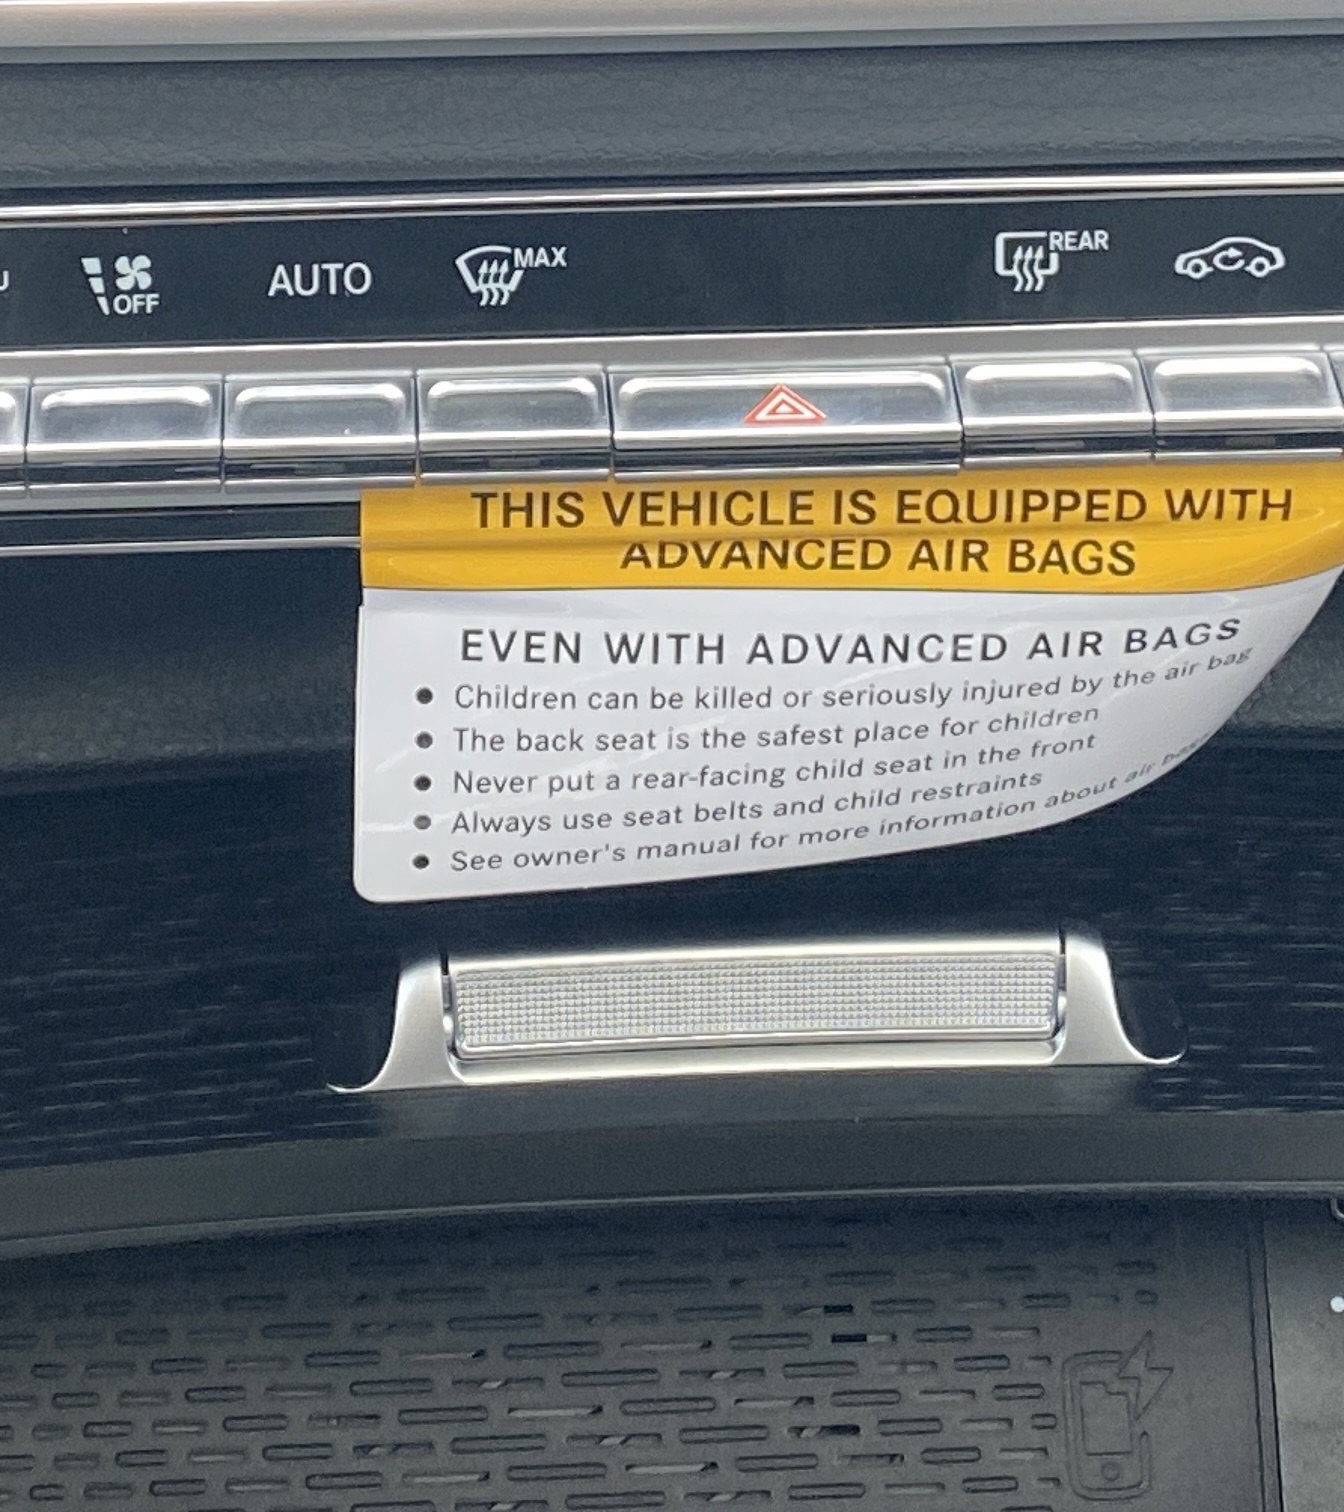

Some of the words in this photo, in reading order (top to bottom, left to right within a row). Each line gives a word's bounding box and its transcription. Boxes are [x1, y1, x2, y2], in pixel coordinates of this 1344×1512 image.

[514, 246, 567, 270] MAX
[1049, 230, 1109, 252] REAR
[268, 261, 373, 298] AUTO
[114, 293, 160, 316] OFF
[471, 491, 585, 528] THIS
[602, 490, 814, 527] VEHICLE
[834, 488, 877, 525] IS
[896, 489, 1147, 525] EQUIPPED
[1165, 488, 1293, 521] WITH
[620, 538, 892, 570] ADVANCED
[908, 539, 989, 572] AIR
[1008, 539, 1137, 577] BAGS
[461, 628, 582, 665] EVEN
[603, 632, 725, 665] WITH
[746, 633, 1007, 665] ADVANCED
[1027, 630, 1103, 660] AIR
[1123, 617, 1241, 654] BAGS
[455, 684, 577, 710] Children
[588, 690, 639, 711] can
[650, 686, 685, 710] be
[695, 684, 772, 710] killed
[783, 689, 812, 708] or
[822, 681, 952, 707] seriously
[962, 678, 1061, 705] injured
[1071, 674, 1103, 696] by
[1112, 668, 1156, 689] the
[1164, 660, 1199, 682] air
[1207, 647, 1254, 673] bag
[453, 727, 505, 753] The
[517, 727, 585, 752] back
[595, 729, 657, 752] seat
[667, 727, 690, 750] is
[700, 725, 747, 749] the
[756, 724, 844, 747] safest
[853, 721, 929, 745] place
[940, 717, 980, 738] for
[988, 705, 1099, 734] children
[453, 770, 538, 794] Never
[548, 770, 596, 797] put
[605, 772, 621, 791] a
[631, 764, 786, 790] rear-facing
[795, 758, 863, 782] child
[874, 755, 933, 777] seat
[944, 750, 968, 770] in
[978, 744, 1021, 767] the
[1031, 733, 1098, 760] front
[450, 850, 504, 872] See
[513, 842, 626, 868] owner's
[637, 833, 740, 861] manual
[749, 829, 786, 850] for
[798, 822, 870, 846] more
[879, 798, 1037, 836] information
[1044, 776, 1118, 809] about
[1124, 762, 1155, 784] air
[451, 810, 552, 838] Always
[563, 810, 612, 832] use
[623, 805, 683, 828] seat
[694, 798, 763, 823] belts
[773, 794, 824, 817] and
[835, 788, 901, 813] child
[911, 770, 1042, 804] restraints
